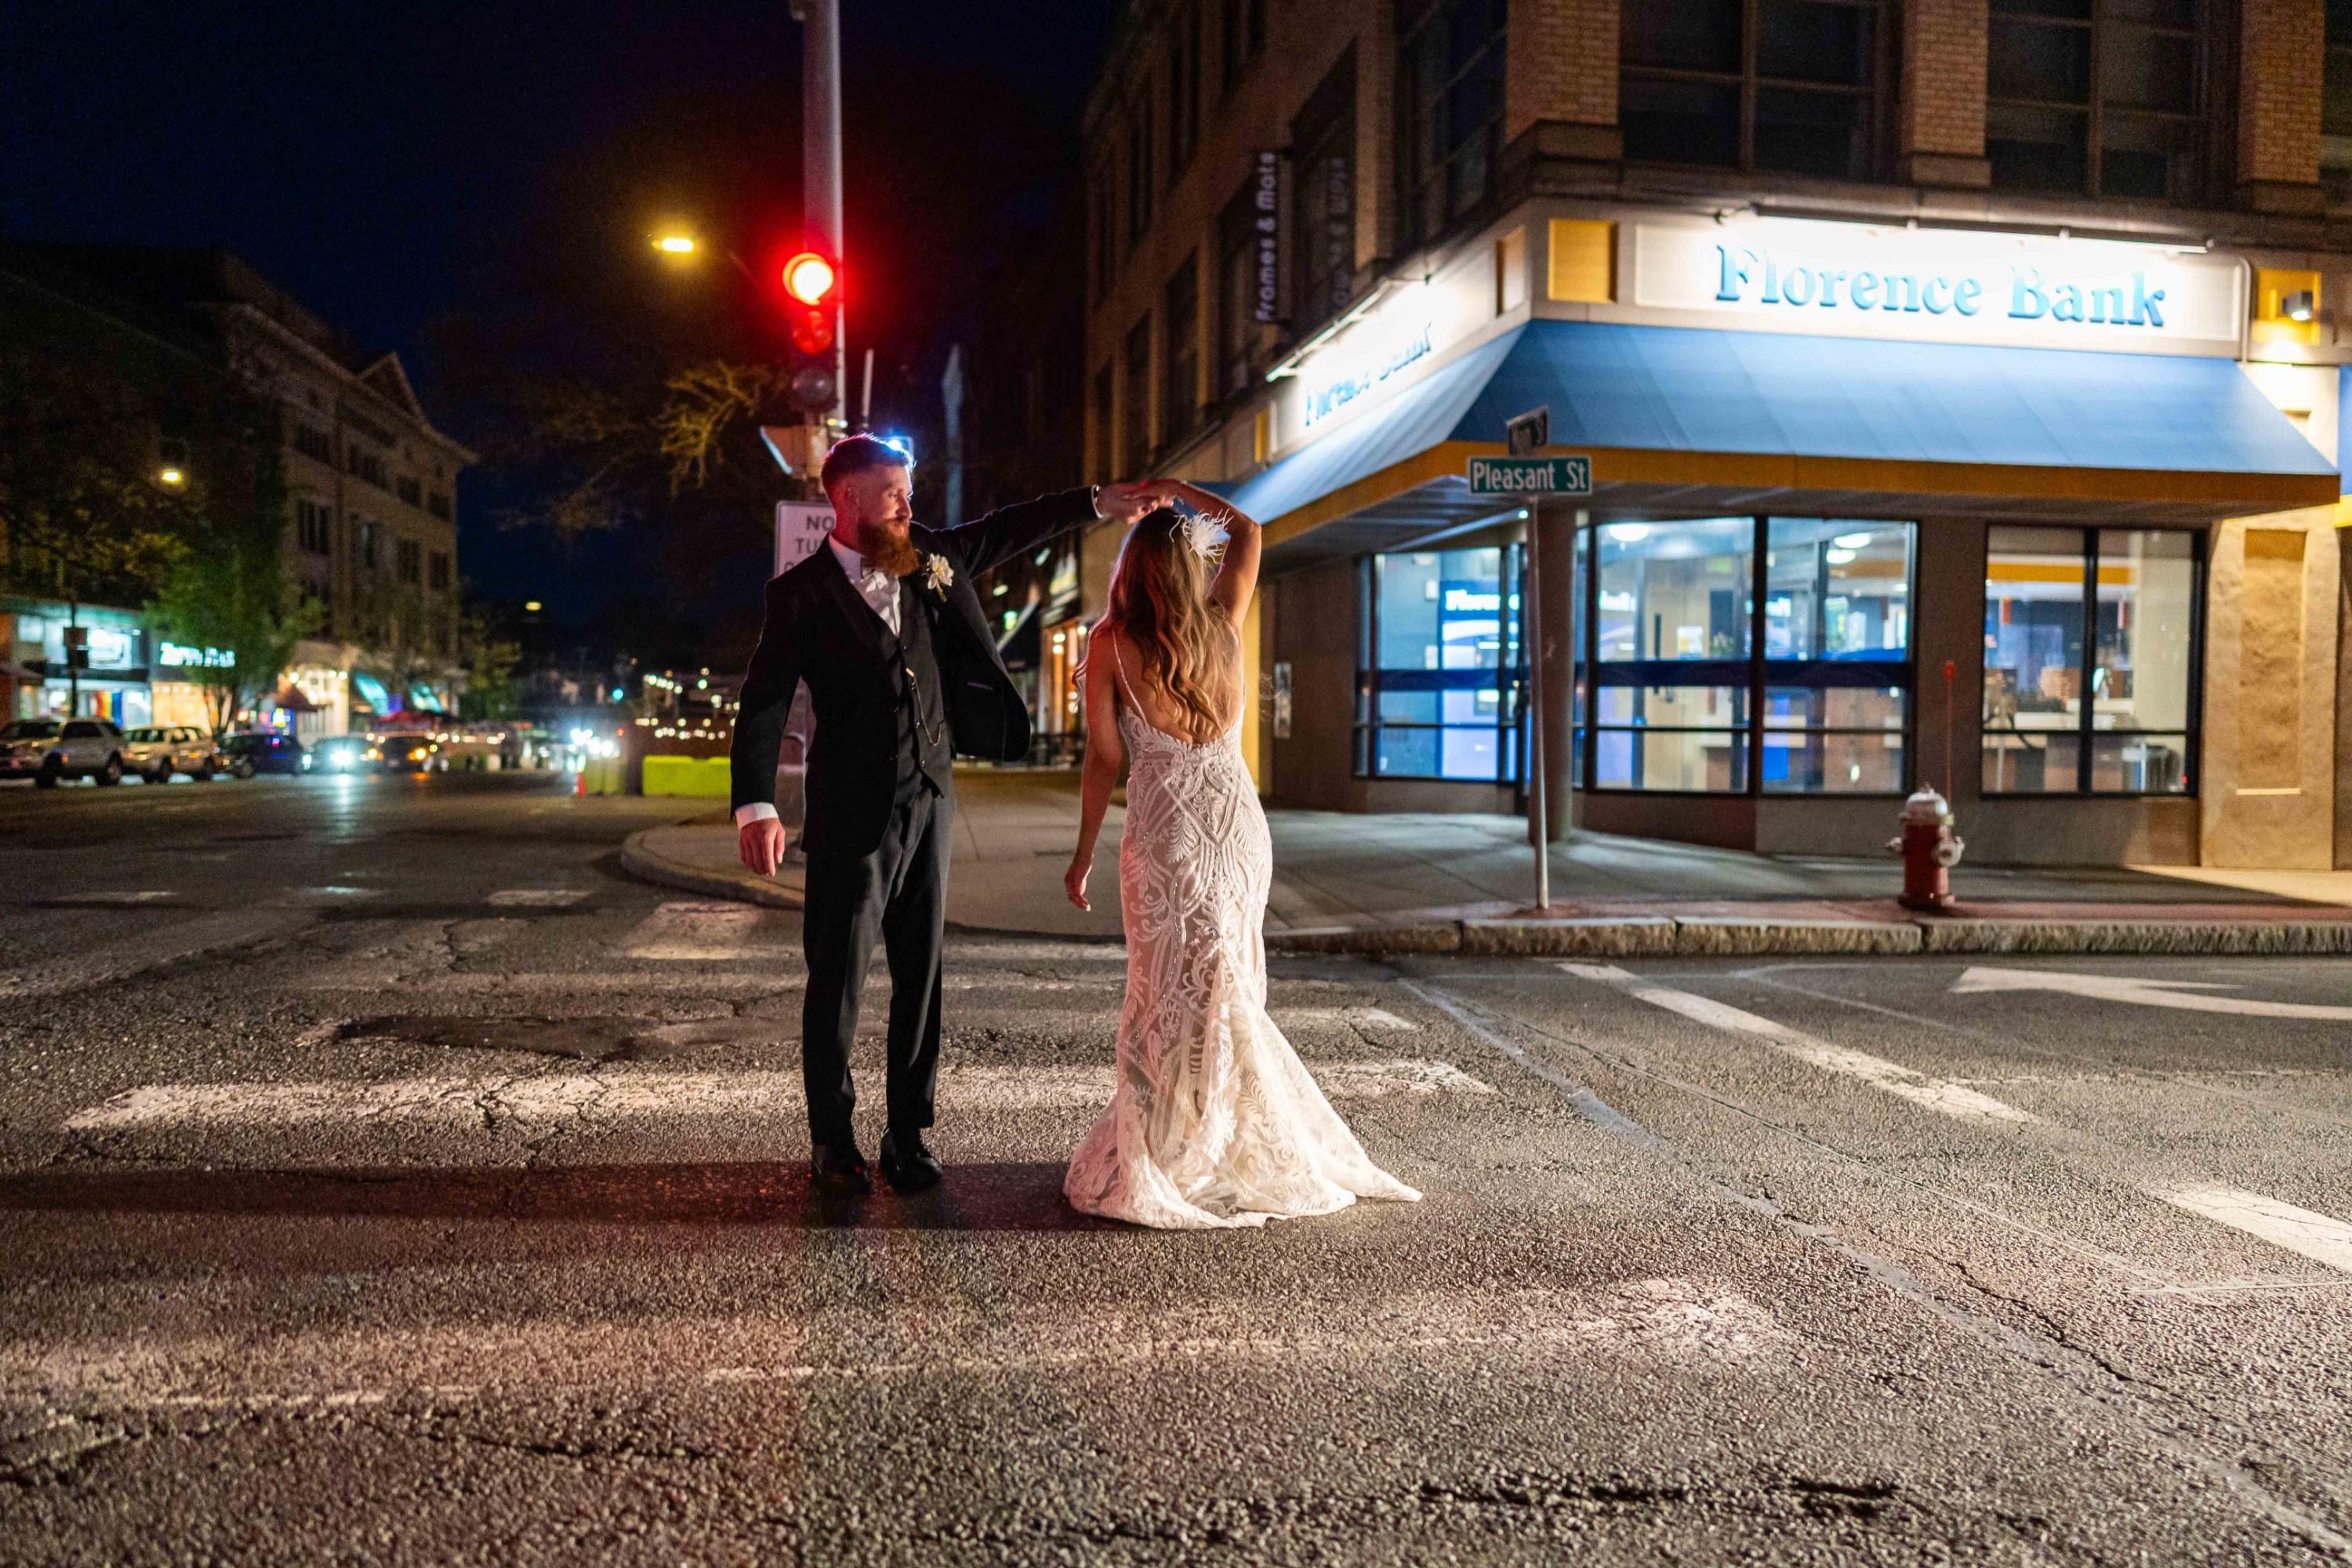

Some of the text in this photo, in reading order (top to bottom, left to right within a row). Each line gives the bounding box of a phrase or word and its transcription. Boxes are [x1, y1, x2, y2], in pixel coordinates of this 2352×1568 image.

[1256, 217, 1276, 233] &
[1715, 245, 2166, 328] Florence Bank
[1473, 460, 1586, 490] Pleasant St
[806, 515, 835, 532] NO
[795, 538, 818, 554] TU
